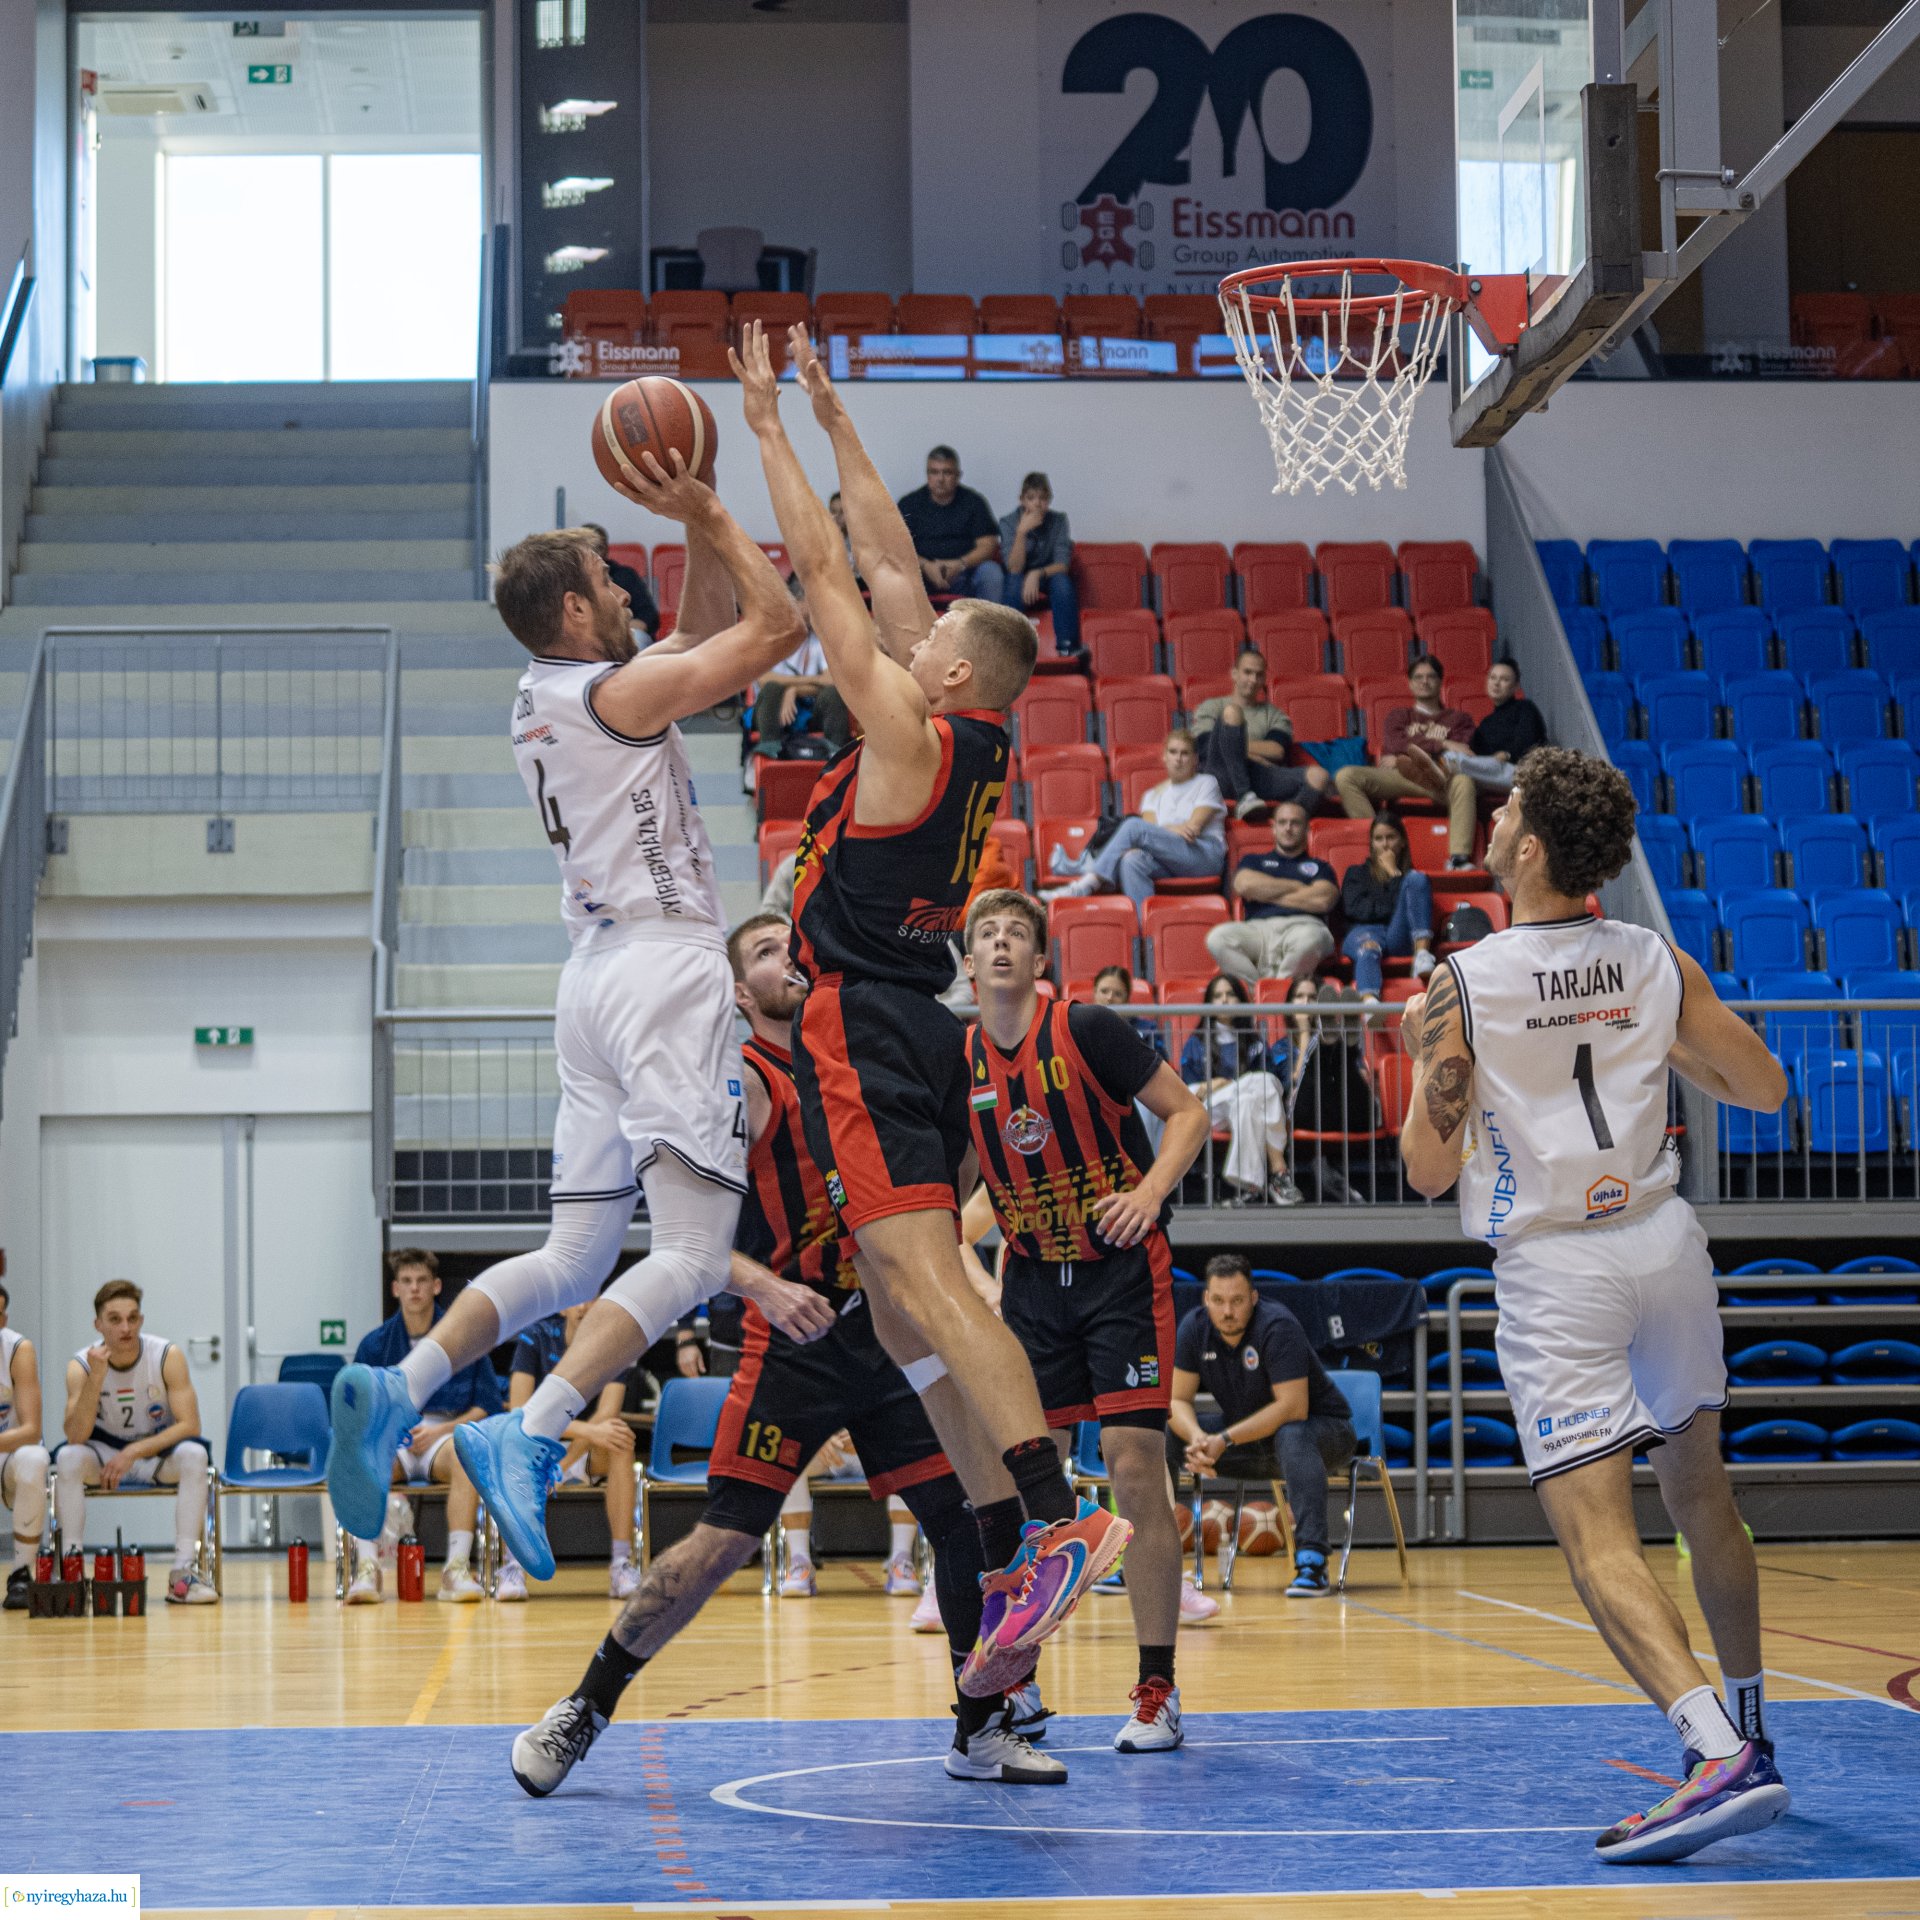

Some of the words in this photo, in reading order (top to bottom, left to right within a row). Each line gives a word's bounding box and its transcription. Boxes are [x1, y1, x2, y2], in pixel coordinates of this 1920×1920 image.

[1062, 12, 1373, 210] 20
[1172, 198, 1356, 238] Eissmann
[1173, 246, 1239, 267] Group
[597, 341, 680, 360] Eissmann
[533, 758, 572, 861] 4
[1532, 958, 1625, 1003] TARJÁN
[1526, 1006, 1632, 1030] BLADESPORT
[1036, 1055, 1070, 1094] 10
[1572, 1043, 1616, 1151] 1
[732, 1101, 746, 1149] 4
[121, 1406, 135, 1429] 2
[1558, 1407, 1611, 1429] HÜBNER
[746, 1420, 782, 1462] 13
[1544, 1438, 1563, 1453] 99.4
[1561, 1429, 1600, 1446] SUNSHINE
[1600, 1427, 1613, 1439] FM
